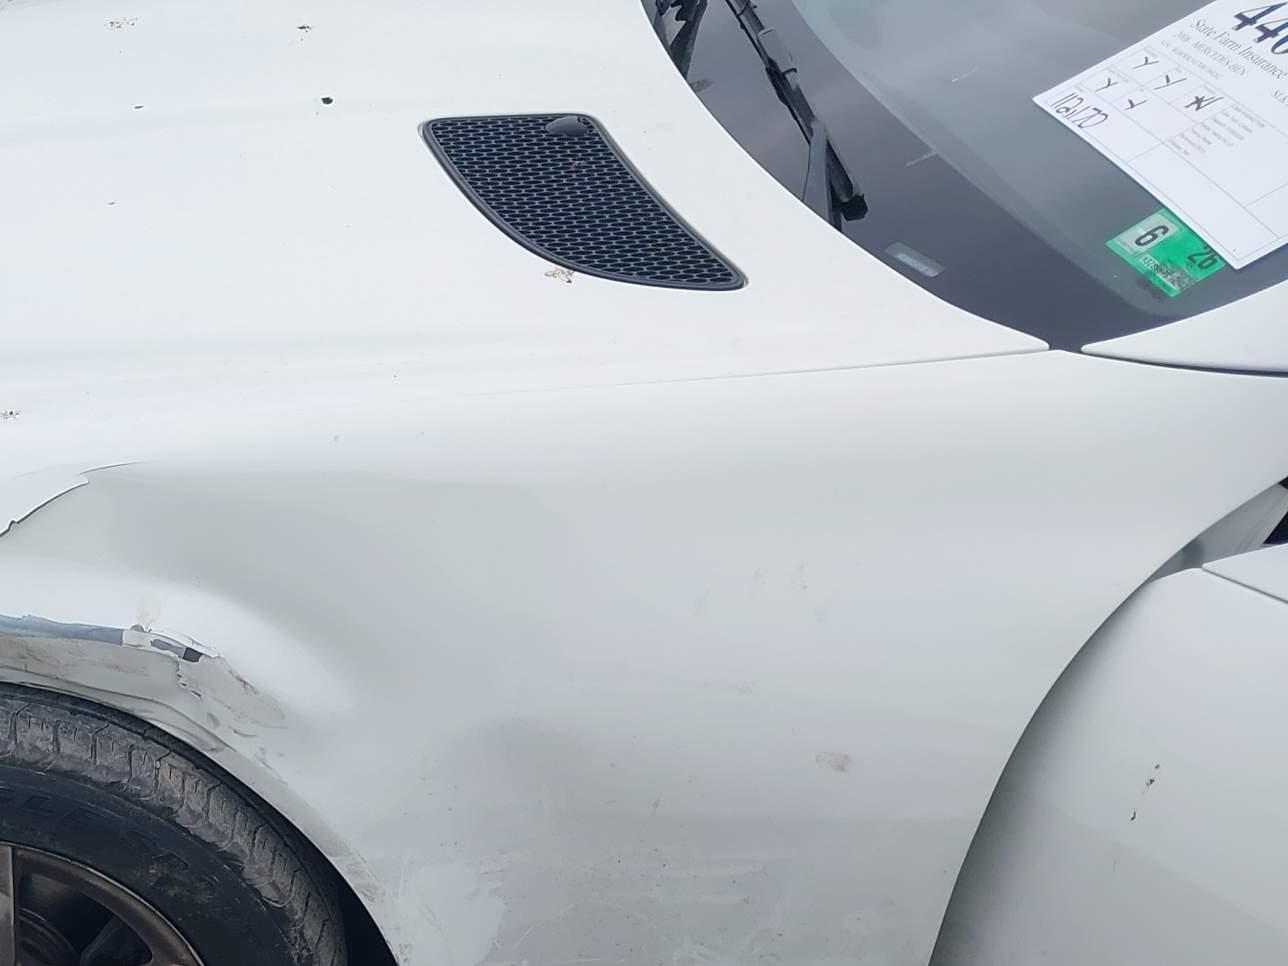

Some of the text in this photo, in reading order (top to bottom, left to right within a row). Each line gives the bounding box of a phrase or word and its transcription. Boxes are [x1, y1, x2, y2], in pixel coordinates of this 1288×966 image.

[1191, 19, 1217, 37] State
[1212, 31, 1241, 51] Farm
[1238, 46, 1288, 79] Insurance
[1135, 225, 1169, 247] 6
